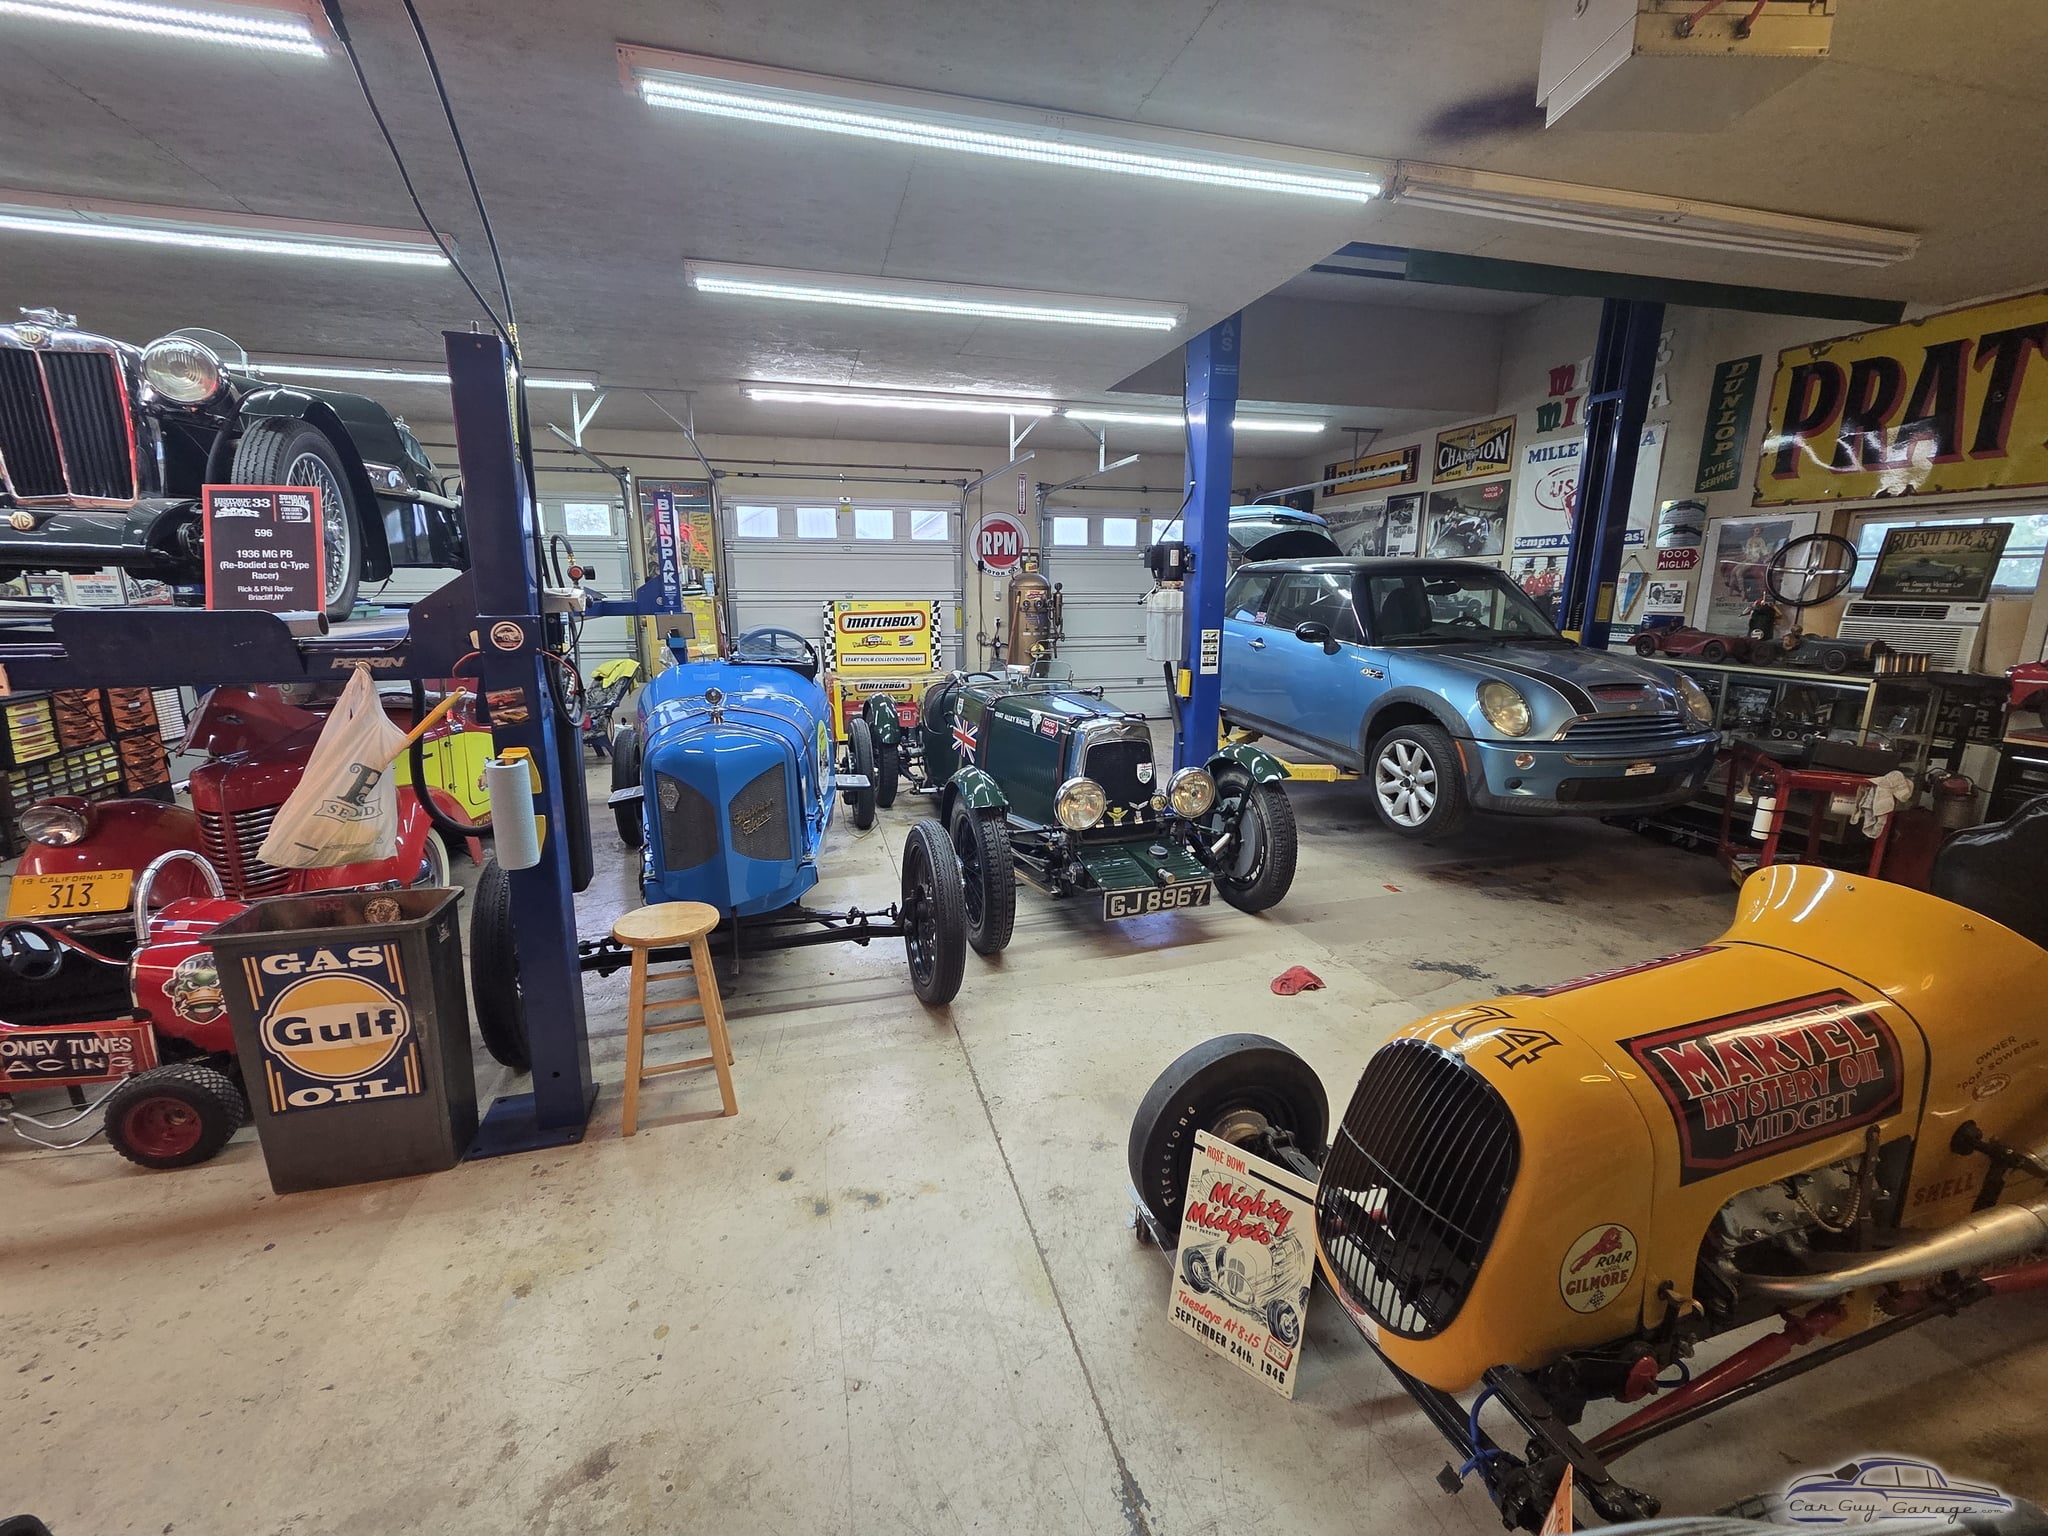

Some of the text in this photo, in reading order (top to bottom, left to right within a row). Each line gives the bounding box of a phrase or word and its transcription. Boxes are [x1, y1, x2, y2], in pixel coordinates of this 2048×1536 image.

[1711, 362, 1749, 456] DUNLOP
[1771, 322, 2048, 480] PRAT
[1439, 430, 1509, 471] CHAMPION
[1528, 442, 1580, 464] MILLE
[1476, 463, 1494, 472] PLUGS
[1700, 470, 1735, 490] SERVICE
[1704, 459, 1734, 477] TYRE
[252, 498, 271, 508] 33
[11, 513, 31, 528] MG
[254, 529, 273, 537] 596
[656, 498, 676, 584] BENDPAK
[982, 531, 1017, 556] RPM
[1515, 536, 1558, 550] Sempre
[1624, 530, 1645, 543] as!
[1887, 528, 1999, 552] BUGATTI TYPE 35
[220, 561, 266, 570] (Re-Bodied
[280, 561, 310, 570] Q-Type
[236, 550, 293, 558] 1936 MG PB
[1657, 560, 1690, 569] MIGLIA
[1662, 550, 1690, 559] 1000
[251, 572, 280, 581] Racer)
[846, 616, 918, 628] MATCHBOX
[40, 874, 103, 884] CALIFORNIA
[110, 872, 124, 880] 39
[48, 883, 94, 909] 313
[1110, 885, 1207, 916] GJ 8967
[261, 945, 384, 975] GAS
[272, 1009, 397, 1047] Gulf
[67, 1037, 133, 1055] TUNES
[1652, 1004, 1880, 1101] MARVEL
[1975, 1035, 2018, 1065] OWNER
[1988, 1038, 2041, 1071] SOWERS
[287, 1078, 407, 1107] OIL
[1701, 1050, 1884, 1130] MYSTERY OIL
[1734, 1089, 1858, 1152] MIDGET
[1161, 1106, 1196, 1208] Firestone
[1206, 1145, 1247, 1176] ROSE BOWL
[1913, 1172, 1975, 1207] SHELL
[1209, 1181, 1294, 1237] Mighty
[1185, 1201, 1272, 1246] Midgets
[1199, 1227, 1220, 1238] PARKING
[1595, 1250, 1633, 1268] ROAR
[1565, 1269, 1629, 1296] GILMORE
[1179, 1290, 1262, 1349] Tuesdays At 8:15
[1175, 1306, 1227, 1349] SEPTEMBER
[1260, 1359, 1285, 1385] 1946
